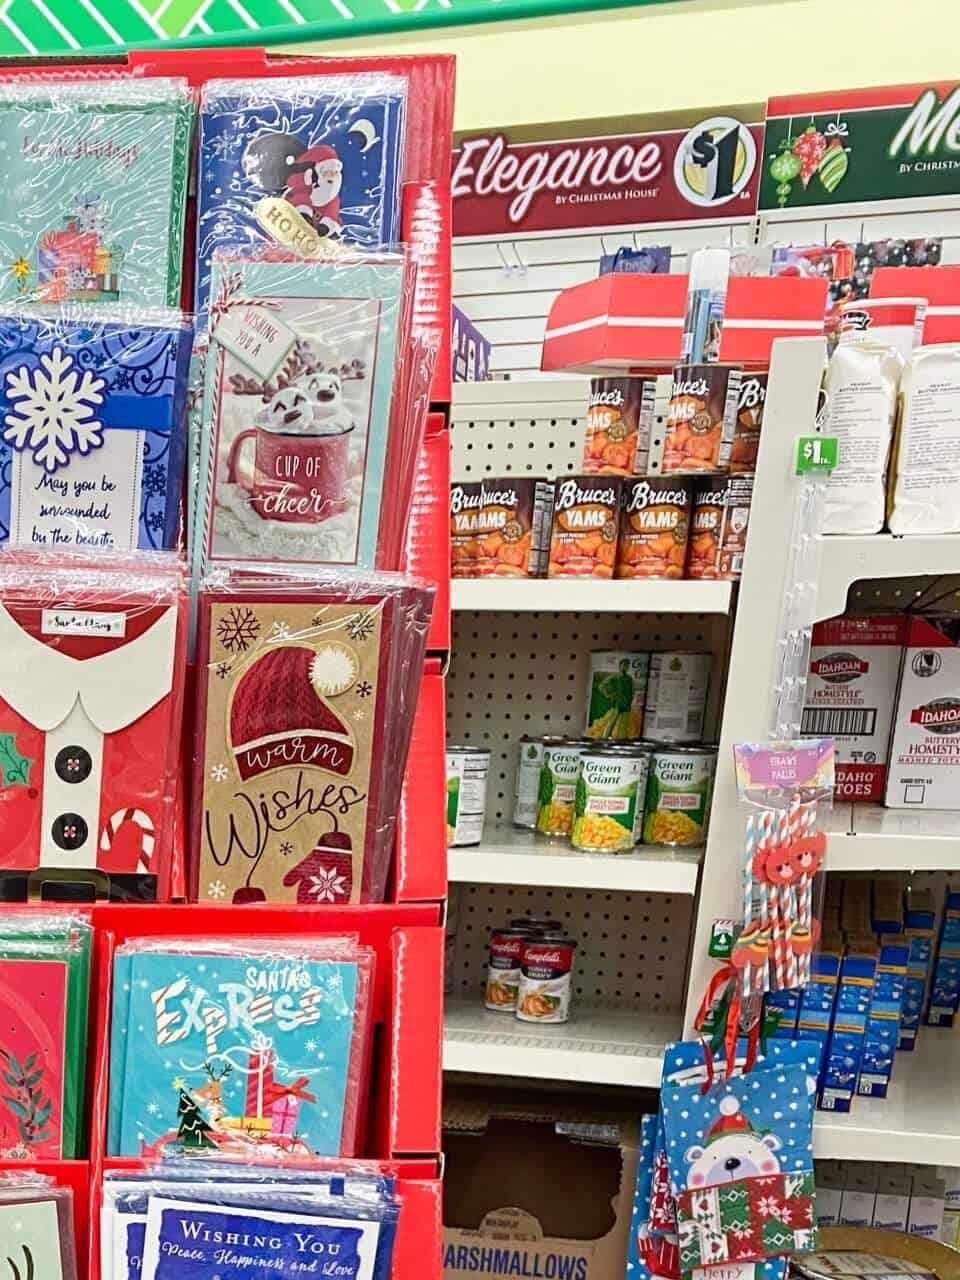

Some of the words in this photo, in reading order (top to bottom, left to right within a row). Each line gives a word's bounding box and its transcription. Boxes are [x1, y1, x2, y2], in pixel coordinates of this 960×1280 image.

[451, 136, 662, 222] Elegance
[569, 191, 622, 203] CHRISTMAS
[244, 309, 279, 344] WISHING
[804, 440, 821, 464] $1
[275, 456, 302, 477] CUP
[306, 456, 322, 476] OF
[34, 473, 69, 497] May
[74, 480, 96, 497] you
[101, 474, 117, 492] be
[555, 481, 616, 510] Bruce's
[254, 484, 347, 516] cheer
[627, 481, 688, 512] Bruce's
[40, 501, 111, 520] surrounded
[566, 510, 606, 527] YAMS
[638, 511, 678, 528] YAMS
[50, 528, 72, 545] the
[818, 662, 862, 675] IDAHOAN
[246, 735, 345, 770] warm
[585, 761, 622, 774] Green
[658, 758, 694, 770] Green
[587, 772, 621, 785] Giant
[660, 770, 694, 782] Giant
[205, 770, 368, 867] Wishes
[161, 1241, 207, 1263] Peace,
[213, 1249, 284, 1270] Happiness
[290, 1260, 317, 1273] and
[321, 1261, 354, 1276] Love
